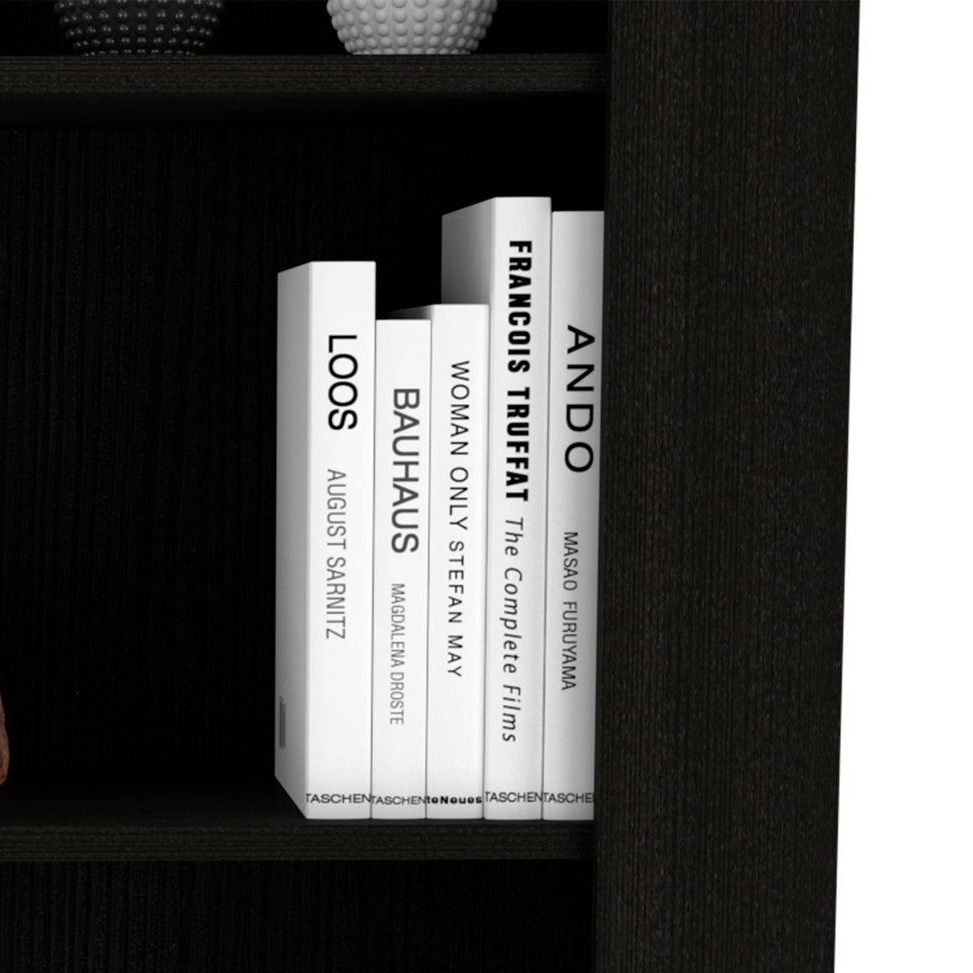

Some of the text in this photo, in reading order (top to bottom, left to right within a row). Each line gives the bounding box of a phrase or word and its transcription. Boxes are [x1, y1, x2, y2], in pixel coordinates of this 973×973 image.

[325, 335, 358, 640] LOOS AUGUST SARNITZ
[389, 388, 420, 726] BAUHAUS MAGDALENA DROSTE
[447, 360, 470, 678] WOMAN ONLY STEFAN MAY
[499, 240, 532, 743] FRANCOIS TRUFFAT The Complete Films
[561, 324, 596, 691] ANDO MASAO FURUYAMA
[305, 792, 372, 805] TASCHEN
[370, 794, 427, 806] TASCHEN
[485, 790, 543, 804] TASCHEN
[542, 791, 595, 804] TASCHE
